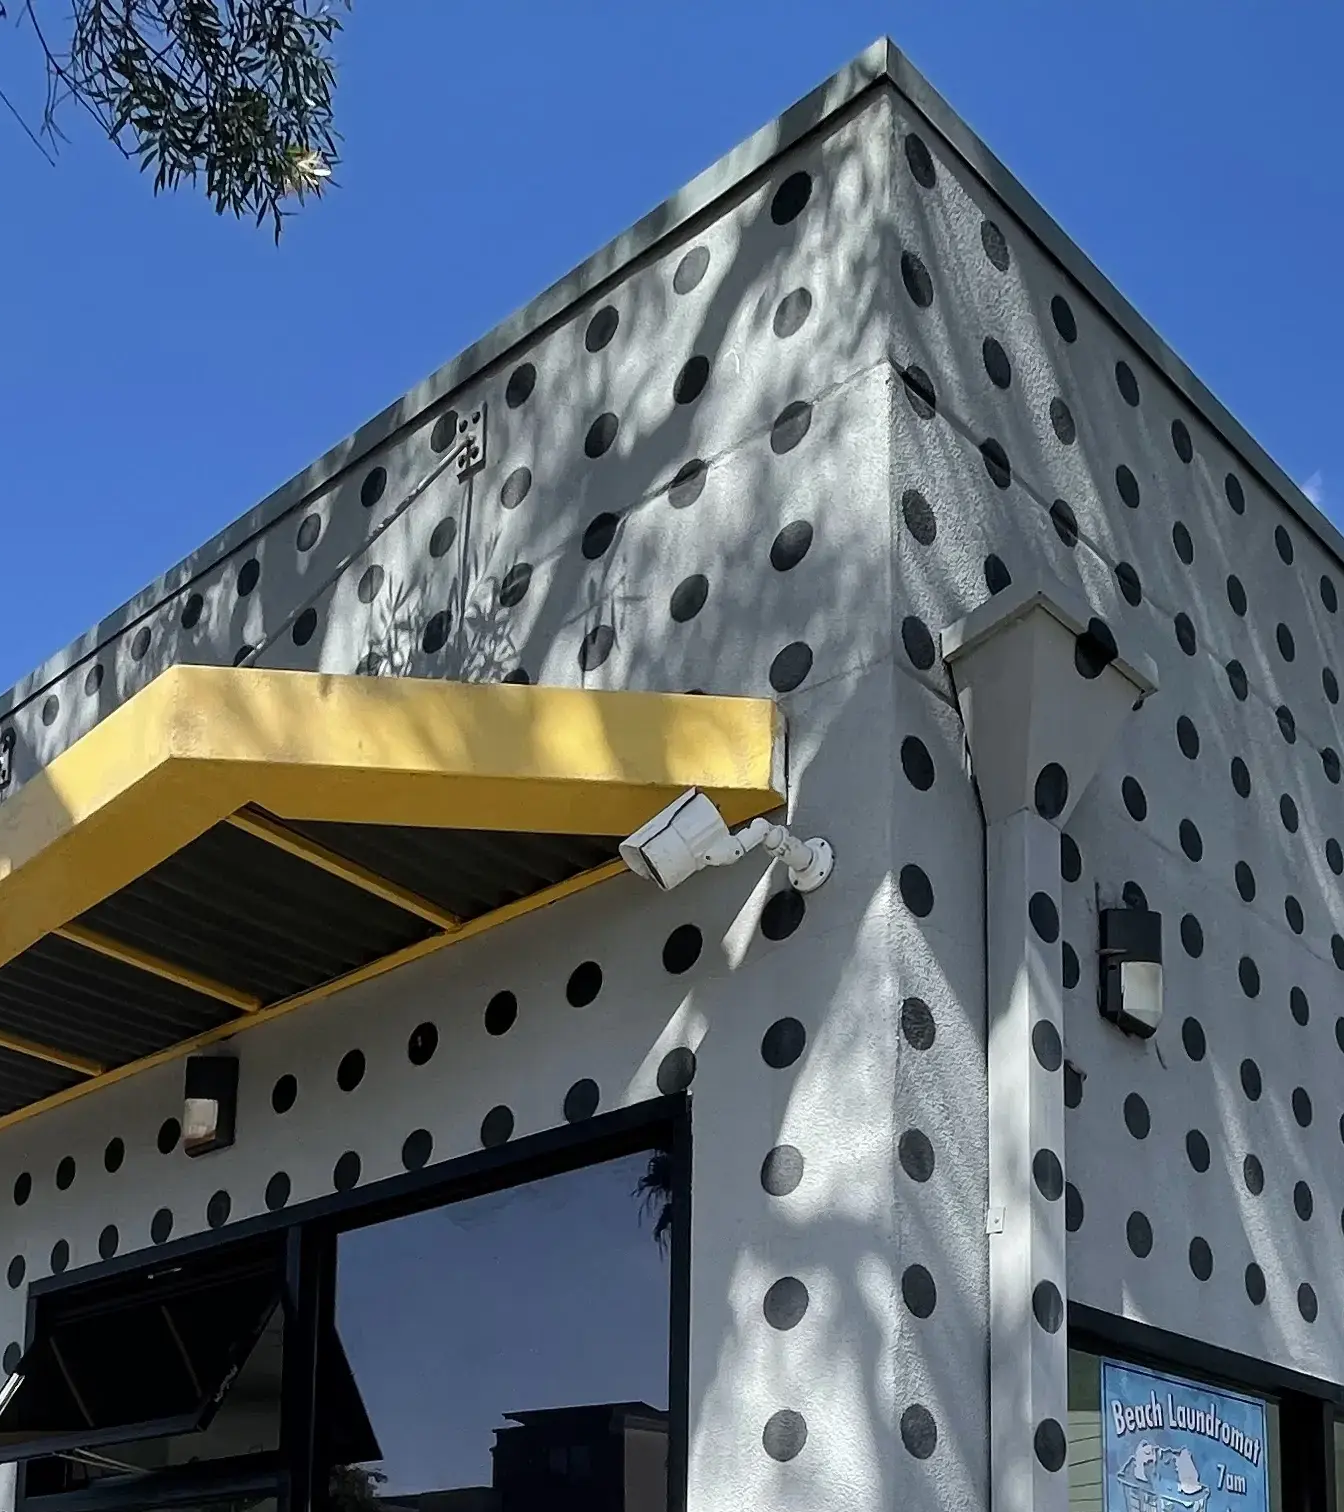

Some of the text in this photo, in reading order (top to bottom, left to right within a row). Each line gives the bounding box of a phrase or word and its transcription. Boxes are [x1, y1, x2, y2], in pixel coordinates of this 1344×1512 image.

[1111, 1390, 1261, 1467] Beach Laundromat
[1216, 1465, 1247, 1495] 7am
